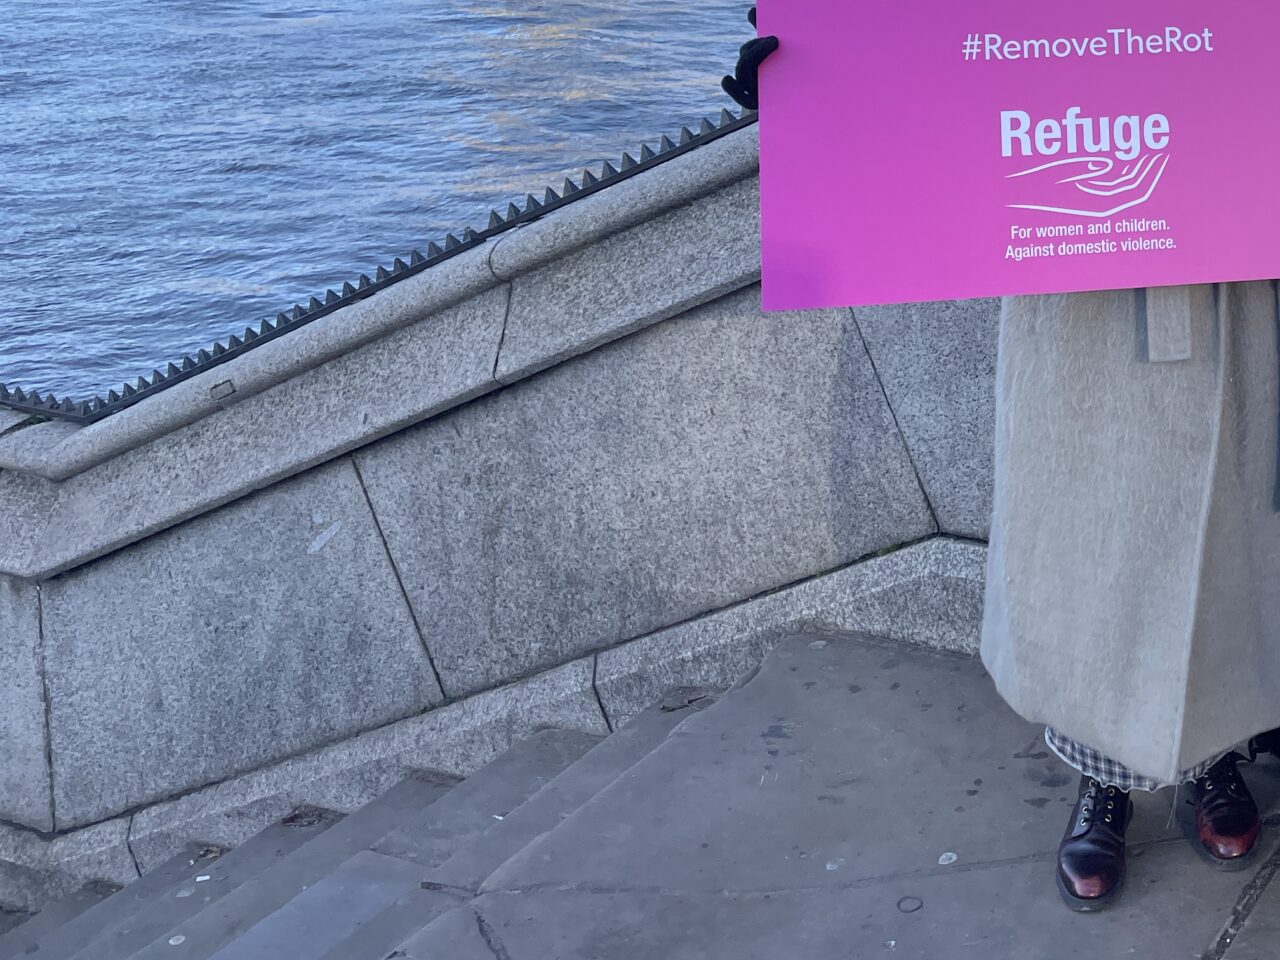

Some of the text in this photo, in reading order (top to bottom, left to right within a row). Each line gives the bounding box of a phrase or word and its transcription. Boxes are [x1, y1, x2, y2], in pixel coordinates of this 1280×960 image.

[961, 26, 1214, 61] #RemoveTheRot
[1000, 106, 1170, 162] Refuge
[1010, 217, 1170, 240] For women and children.
[1004, 237, 1177, 261] Against domestic violence.
